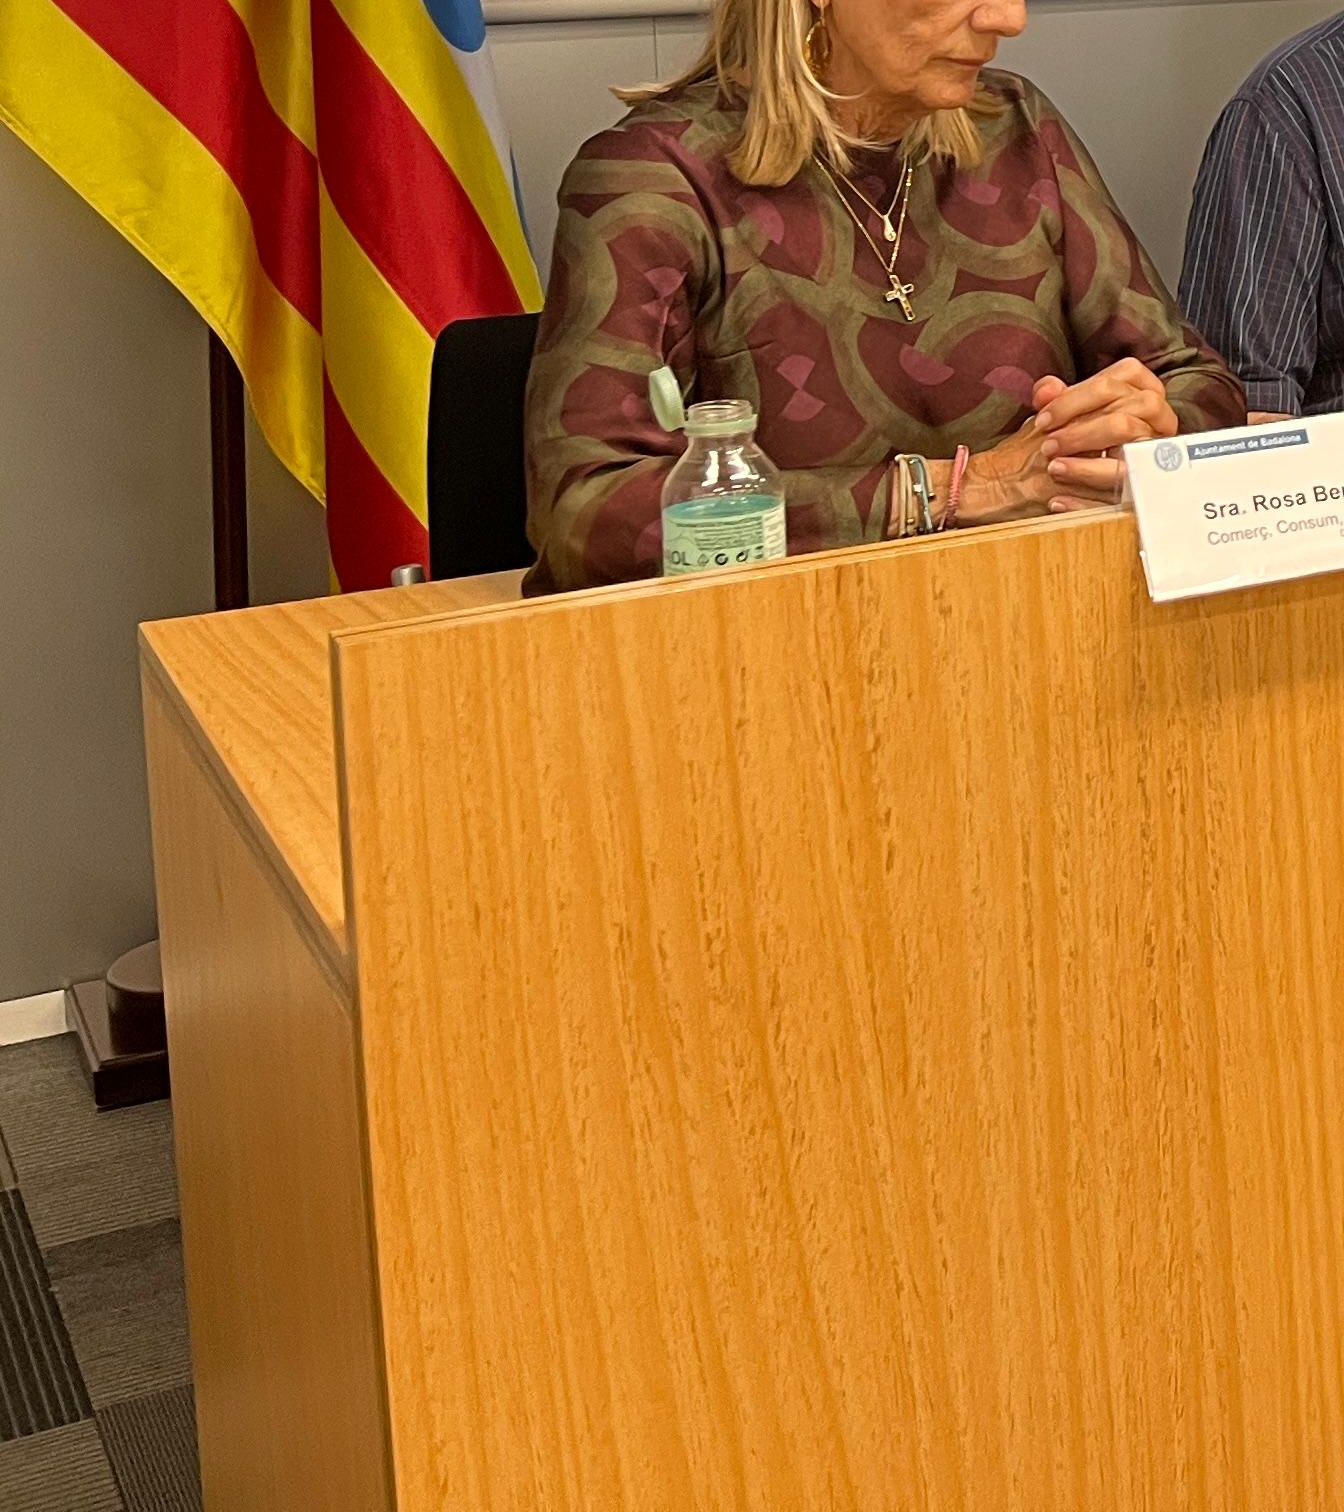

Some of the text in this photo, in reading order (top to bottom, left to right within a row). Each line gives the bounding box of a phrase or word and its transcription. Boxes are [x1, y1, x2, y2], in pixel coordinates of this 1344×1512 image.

[1203, 502, 1246, 520] Sra.
[1253, 492, 1307, 512] Rosa
[1276, 514, 1344, 534] Consum,
